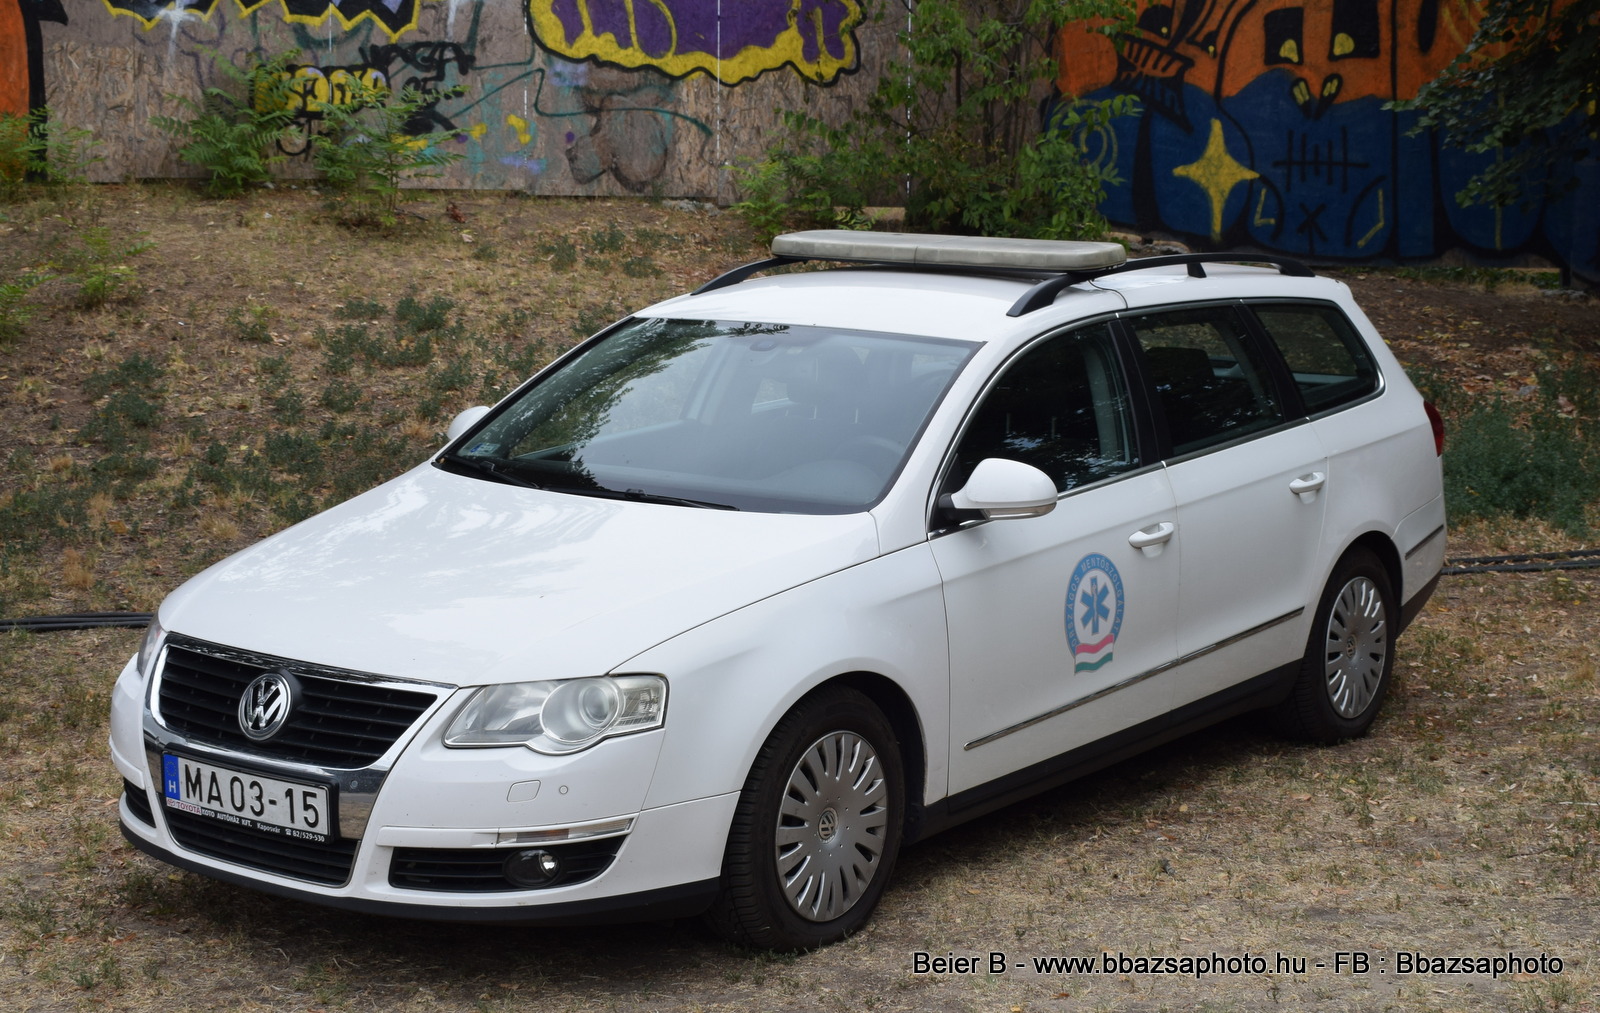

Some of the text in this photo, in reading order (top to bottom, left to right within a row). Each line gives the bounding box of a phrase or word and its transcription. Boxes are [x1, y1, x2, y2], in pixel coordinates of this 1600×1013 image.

[168, 779, 177, 793] H
[184, 764, 320, 829] MA03-15
[176, 801, 202, 815] TOYOTA
[292, 829, 325, 843] 82/529-530
